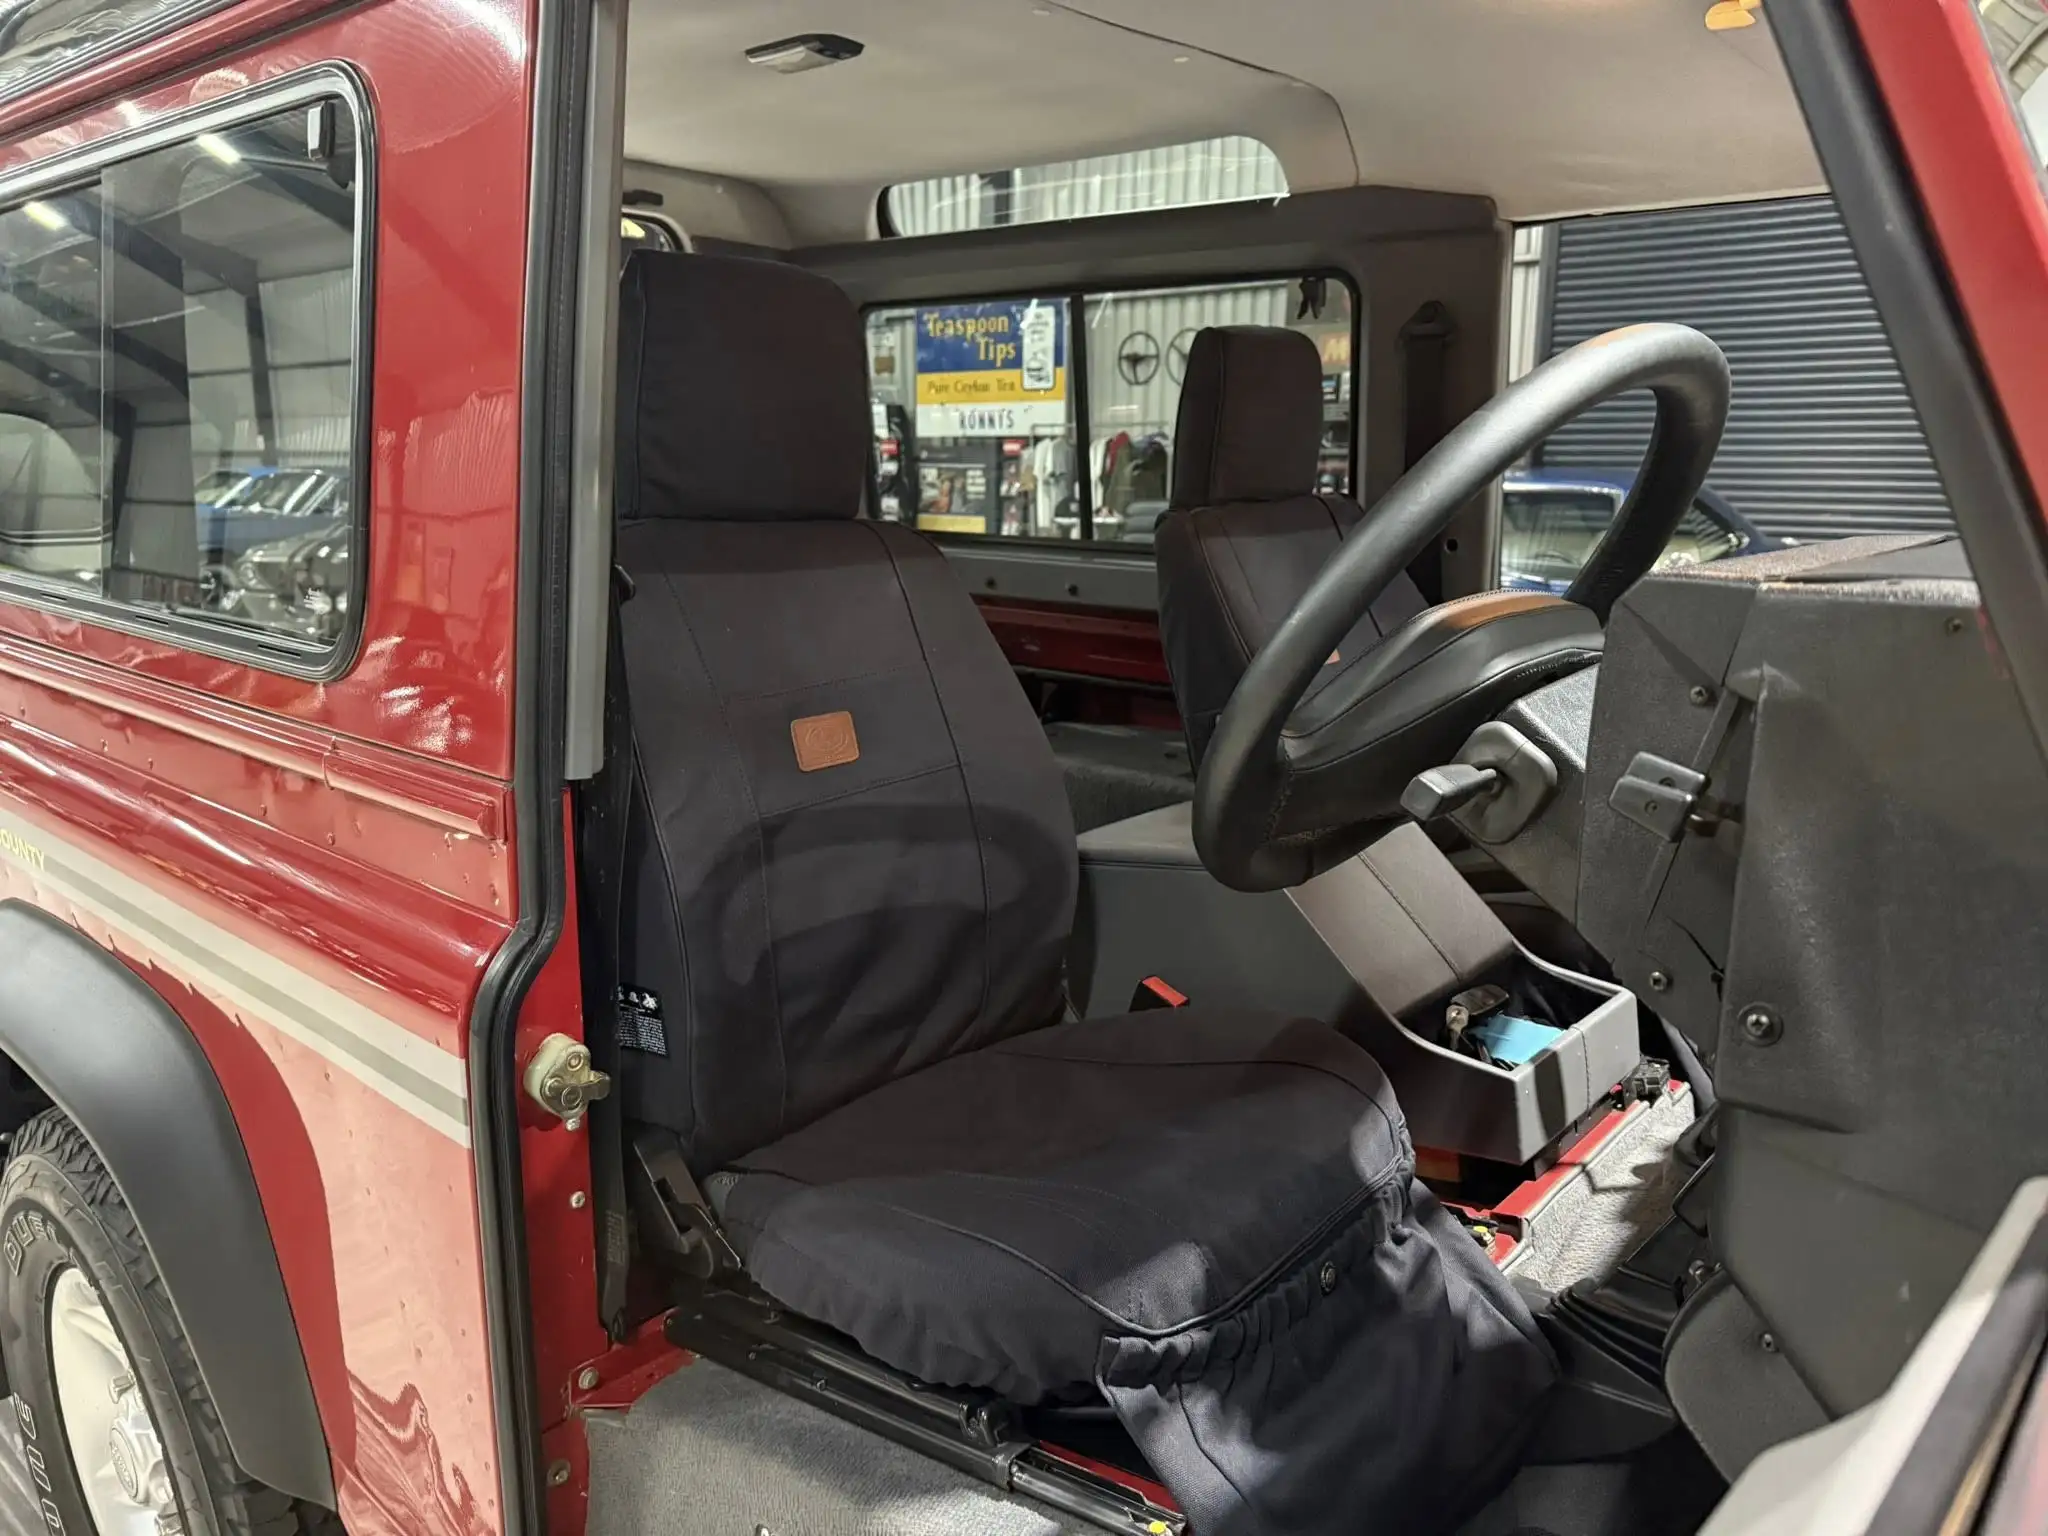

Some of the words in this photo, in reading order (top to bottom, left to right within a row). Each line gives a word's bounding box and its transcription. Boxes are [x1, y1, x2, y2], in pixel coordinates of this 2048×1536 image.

[925, 313, 1009, 341] Teaspoon
[978, 337, 1016, 367] Tips
[996, 378, 1015, 392] Tea
